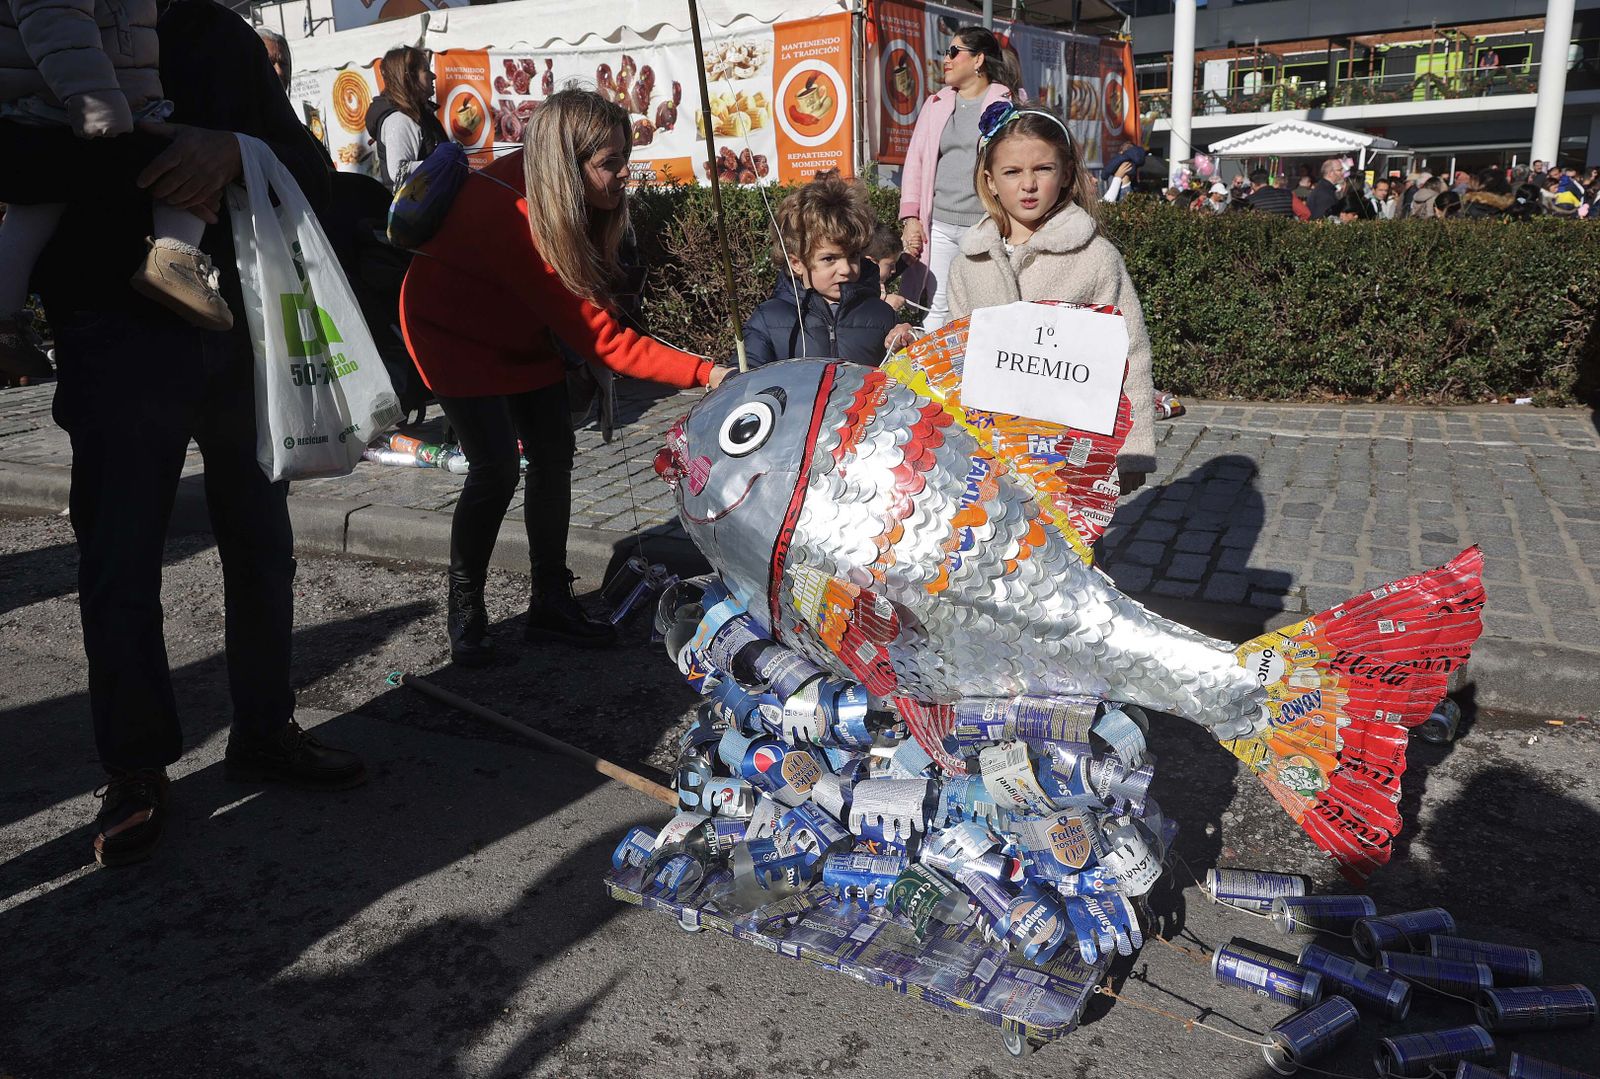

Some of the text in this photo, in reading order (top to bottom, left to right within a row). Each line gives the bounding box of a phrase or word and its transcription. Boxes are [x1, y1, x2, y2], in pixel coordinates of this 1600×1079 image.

[782, 36, 840, 51] MANTENIENDO
[781, 46, 840, 60] LA TRADICIÓN
[787, 150, 843, 160] REPARTIENDO
[791, 160, 837, 169] MOMENTOS
[995, 350, 1090, 383] PREMIO
[1257, 646, 1277, 682] ÓNIC
[1050, 824, 1083, 842] Falke
[1054, 834, 1087, 851] TOSTADA
[1013, 904, 1048, 939] Mahou
